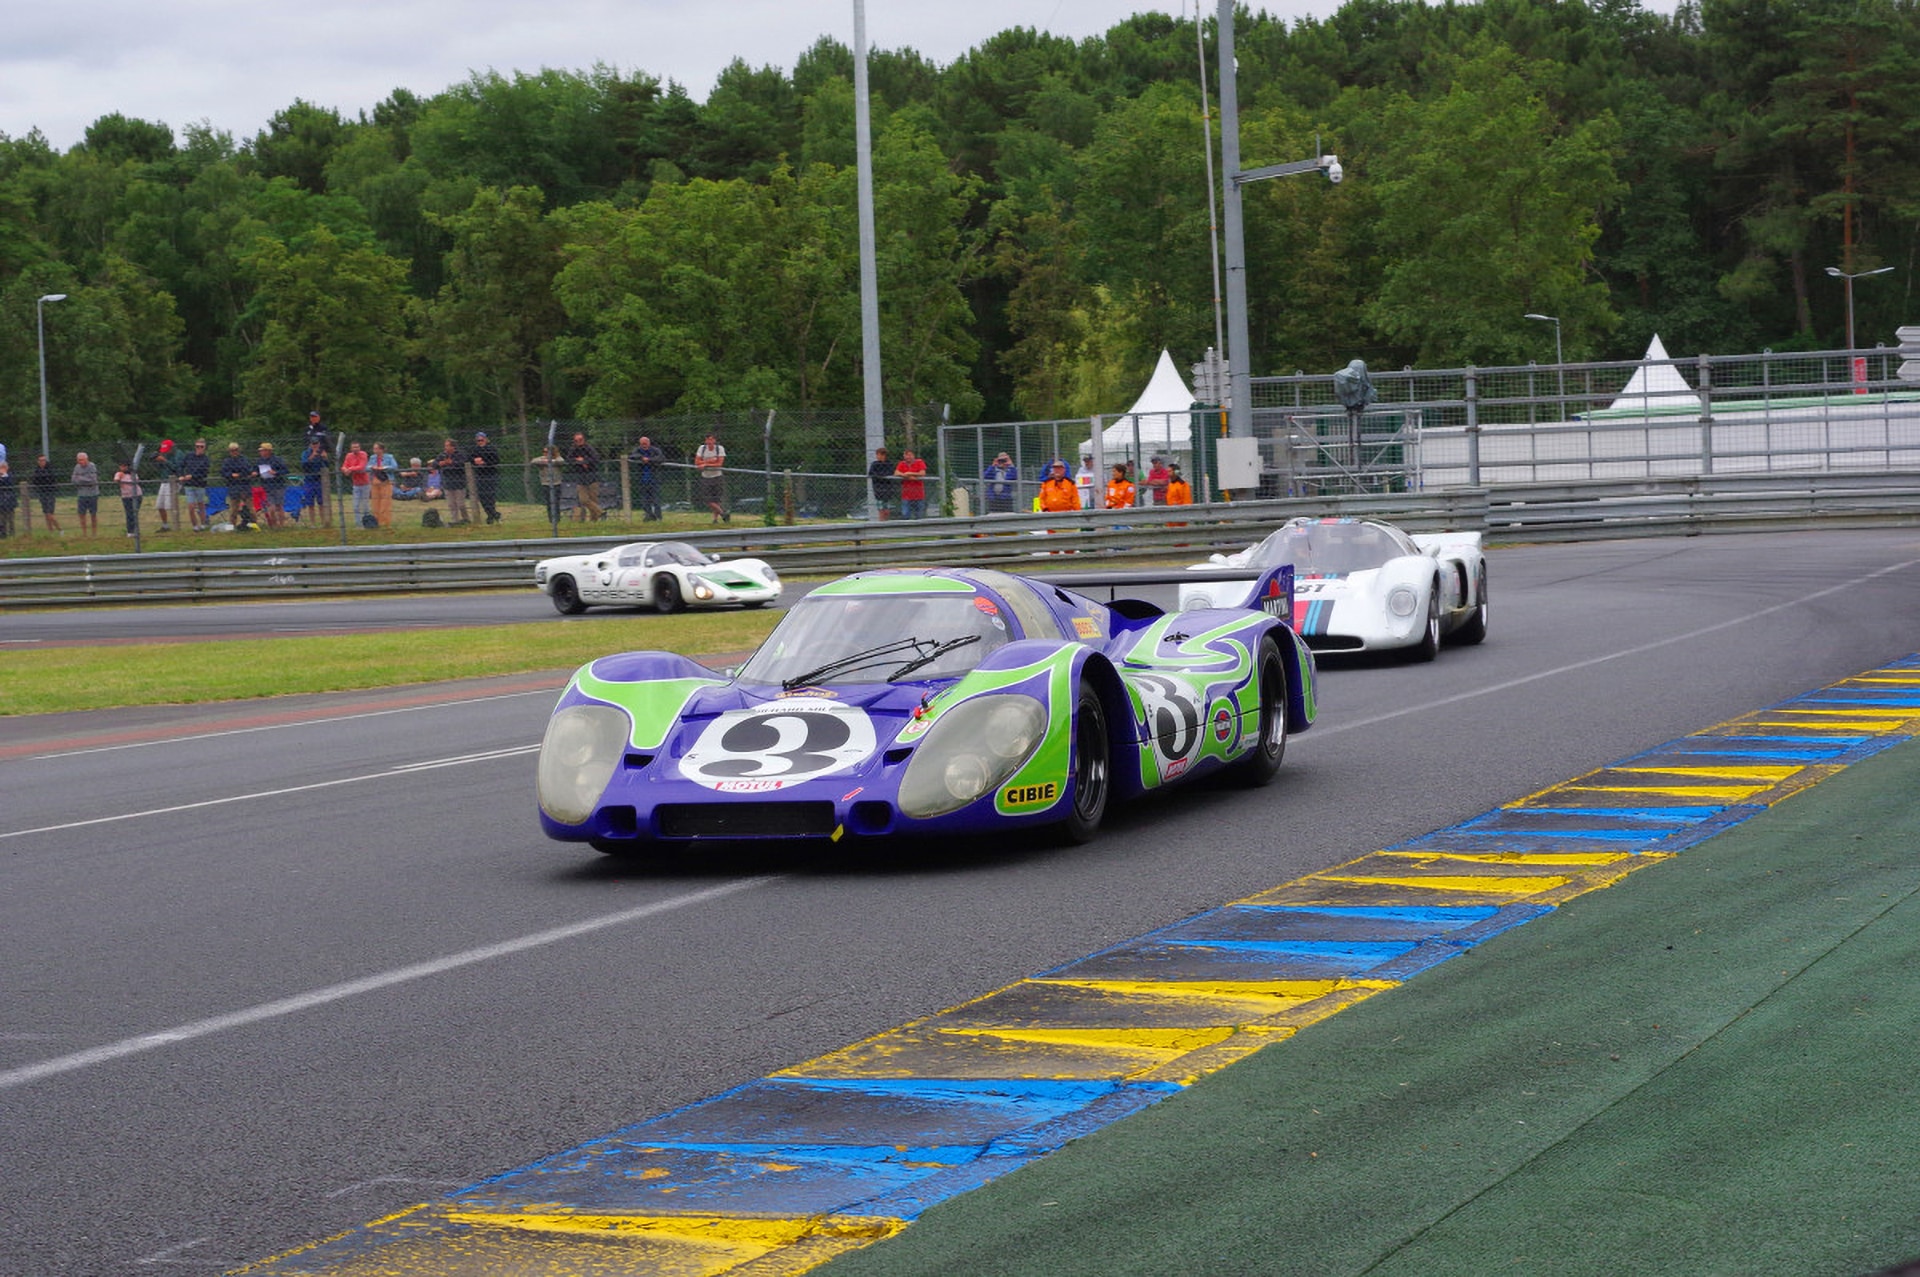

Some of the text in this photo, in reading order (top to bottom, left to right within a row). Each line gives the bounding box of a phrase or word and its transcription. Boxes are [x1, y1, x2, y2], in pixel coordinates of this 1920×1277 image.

[582, 590, 644, 599] PORSCHE
[1126, 673, 1198, 760] 3
[698, 711, 851, 777] 3
[721, 780, 778, 792] MOTUL
